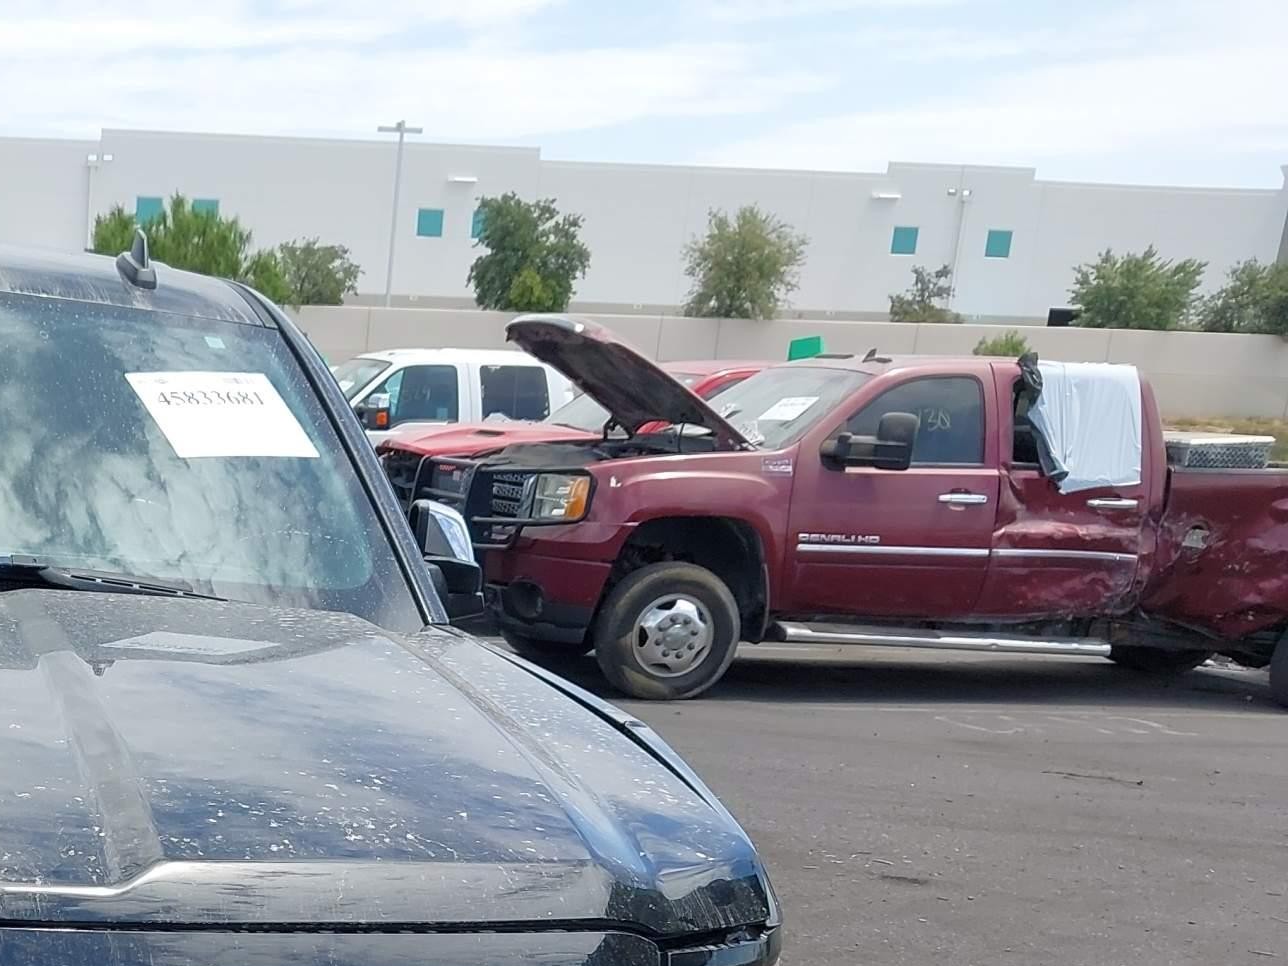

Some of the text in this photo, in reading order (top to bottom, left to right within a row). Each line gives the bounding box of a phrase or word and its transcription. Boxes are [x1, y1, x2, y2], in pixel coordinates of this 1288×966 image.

[157, 390, 266, 407] 45833681
[798, 533, 880, 544] DENALI HD
